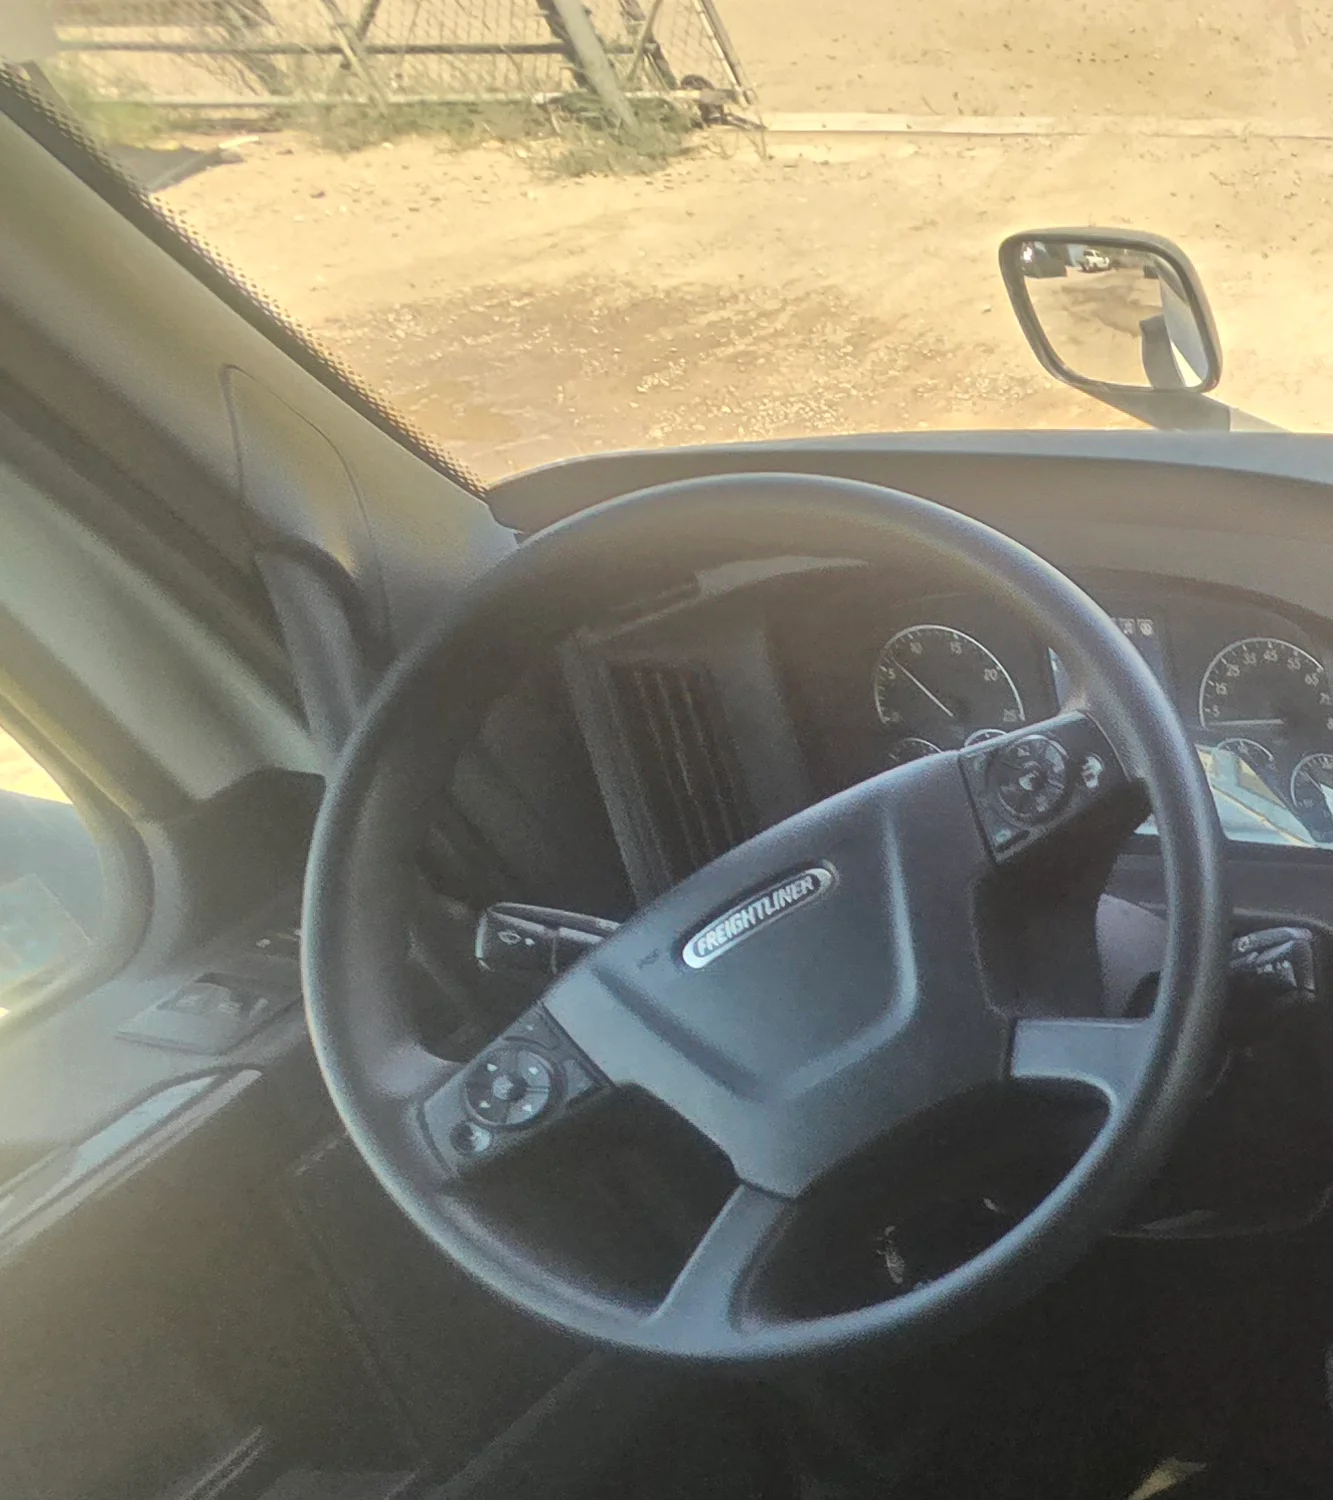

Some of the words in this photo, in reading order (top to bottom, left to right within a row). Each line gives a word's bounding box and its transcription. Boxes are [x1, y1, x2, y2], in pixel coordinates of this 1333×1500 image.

[1243, 653, 1257, 666] 35
[1287, 657, 1301, 671] 55
[888, 668, 896, 680] 5
[1304, 673, 1320, 687] 65
[1212, 705, 1220, 717] 5
[697, 875, 815, 956] FREIGHTLINER
